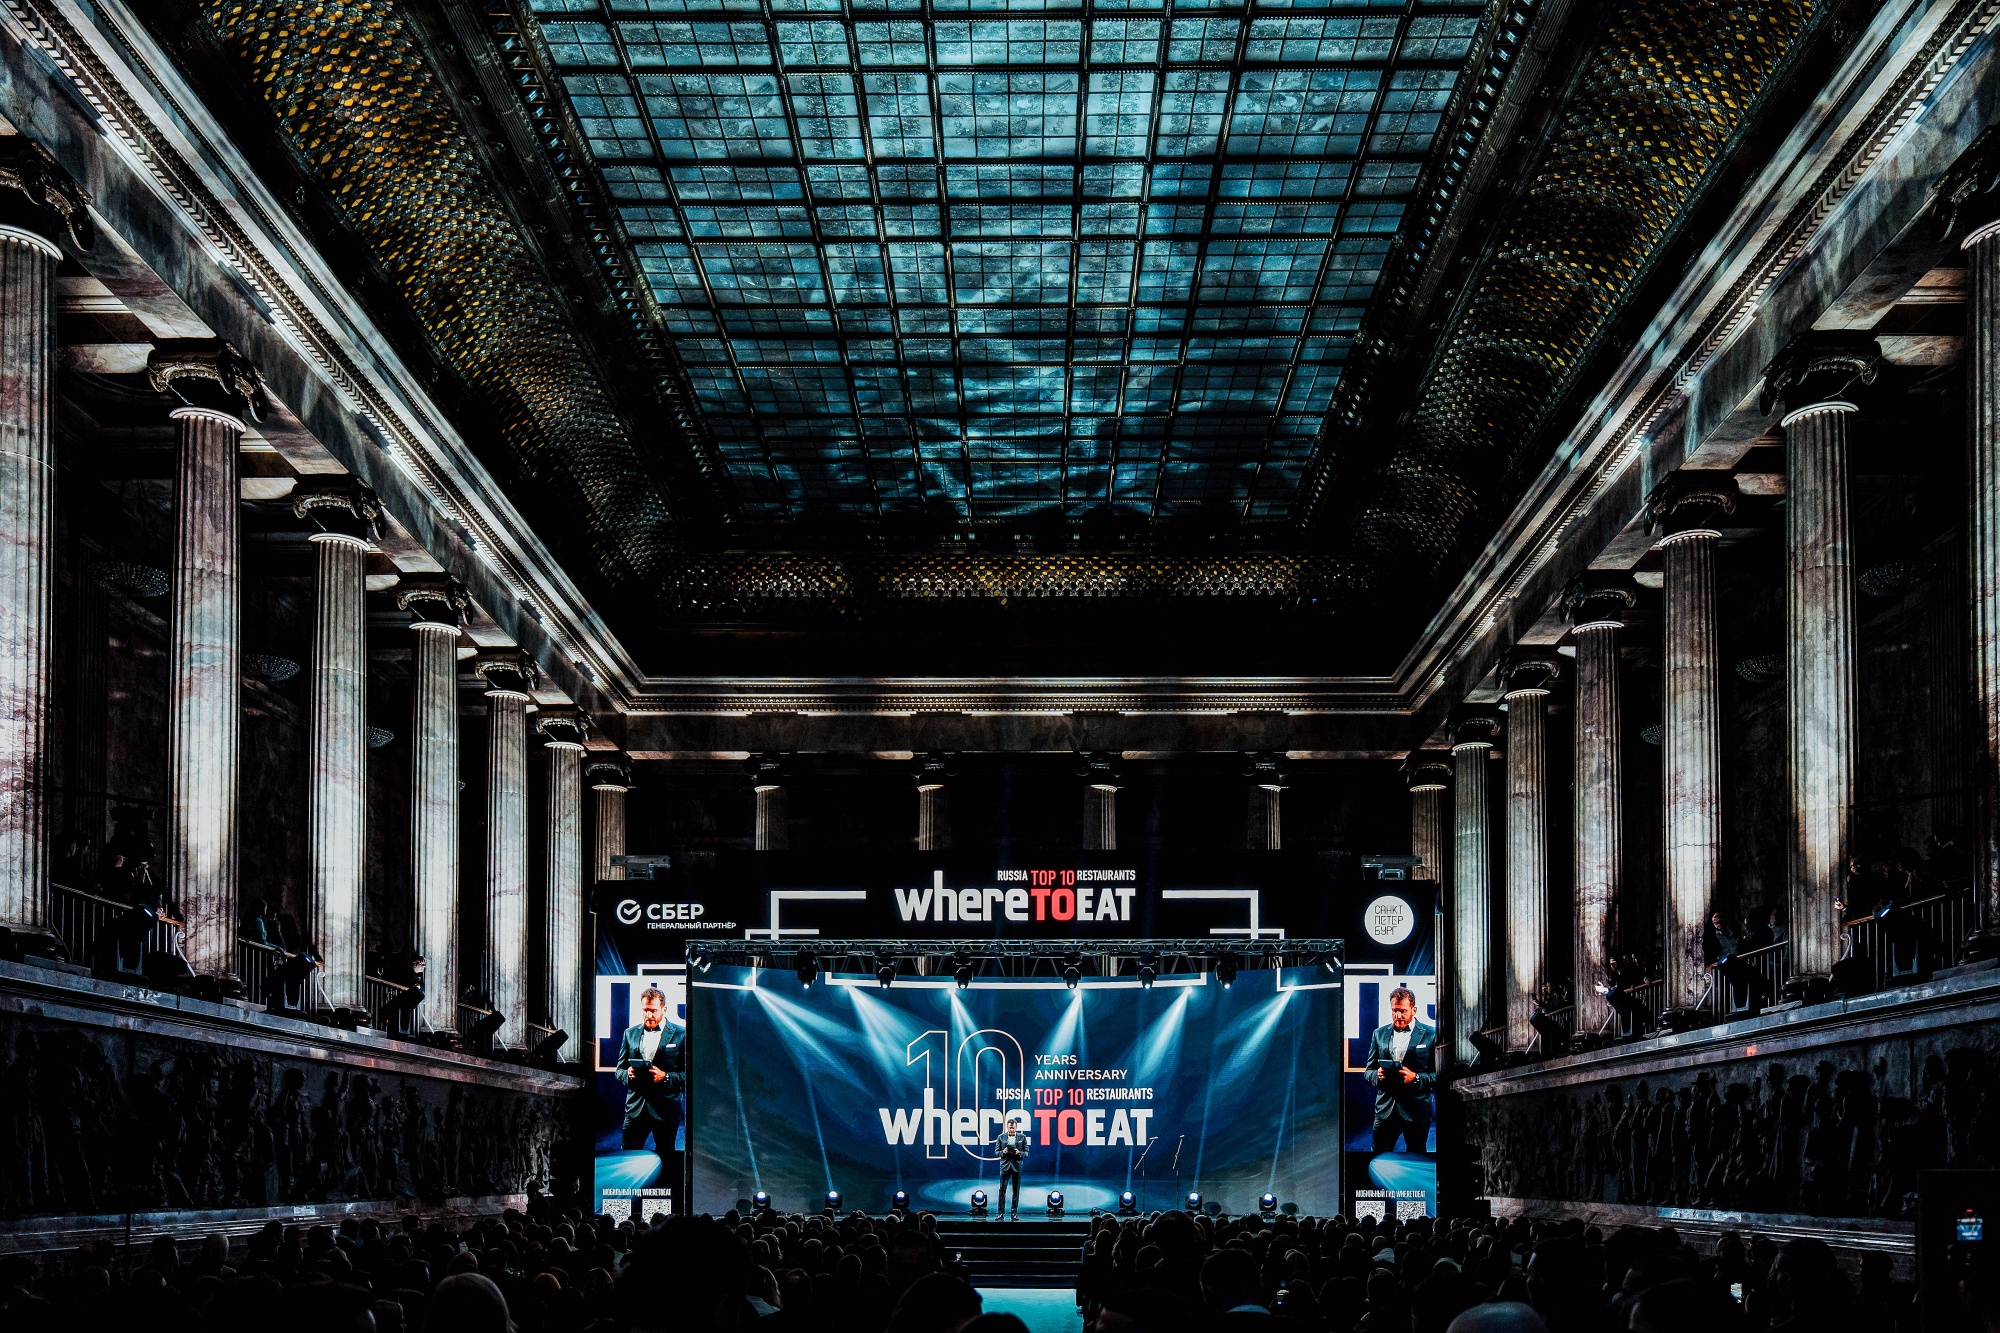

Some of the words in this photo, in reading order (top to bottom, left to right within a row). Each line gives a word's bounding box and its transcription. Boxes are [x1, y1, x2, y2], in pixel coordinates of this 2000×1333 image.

[998, 871, 1028, 881] RUSSIA
[1030, 870, 1056, 885] TOP
[1060, 870, 1075, 885] 10
[1077, 870, 1136, 881] RESTAURANTS
[646, 903, 705, 920] СБЕР
[1374, 904, 1403, 914] САНКТ
[647, 921, 702, 929] ГЕНЕРАЛЬНЫЙ
[703, 921, 737, 929] ПАРТНЁР
[1374, 915, 1404, 925] ПЕТЕР
[1374, 926, 1397, 935] БУРГ
[1034, 1054, 1077, 1065] YEARS
[1034, 1069, 1128, 1080] ANNIVERSARY
[907, 1029, 1024, 1161] 10
[996, 1088, 1031, 1100] RUSSIA
[1034, 1088, 1063, 1106] TOP
[1067, 1088, 1085, 1106] 10
[1086, 1088, 1153, 1100] RESTAURANTS
